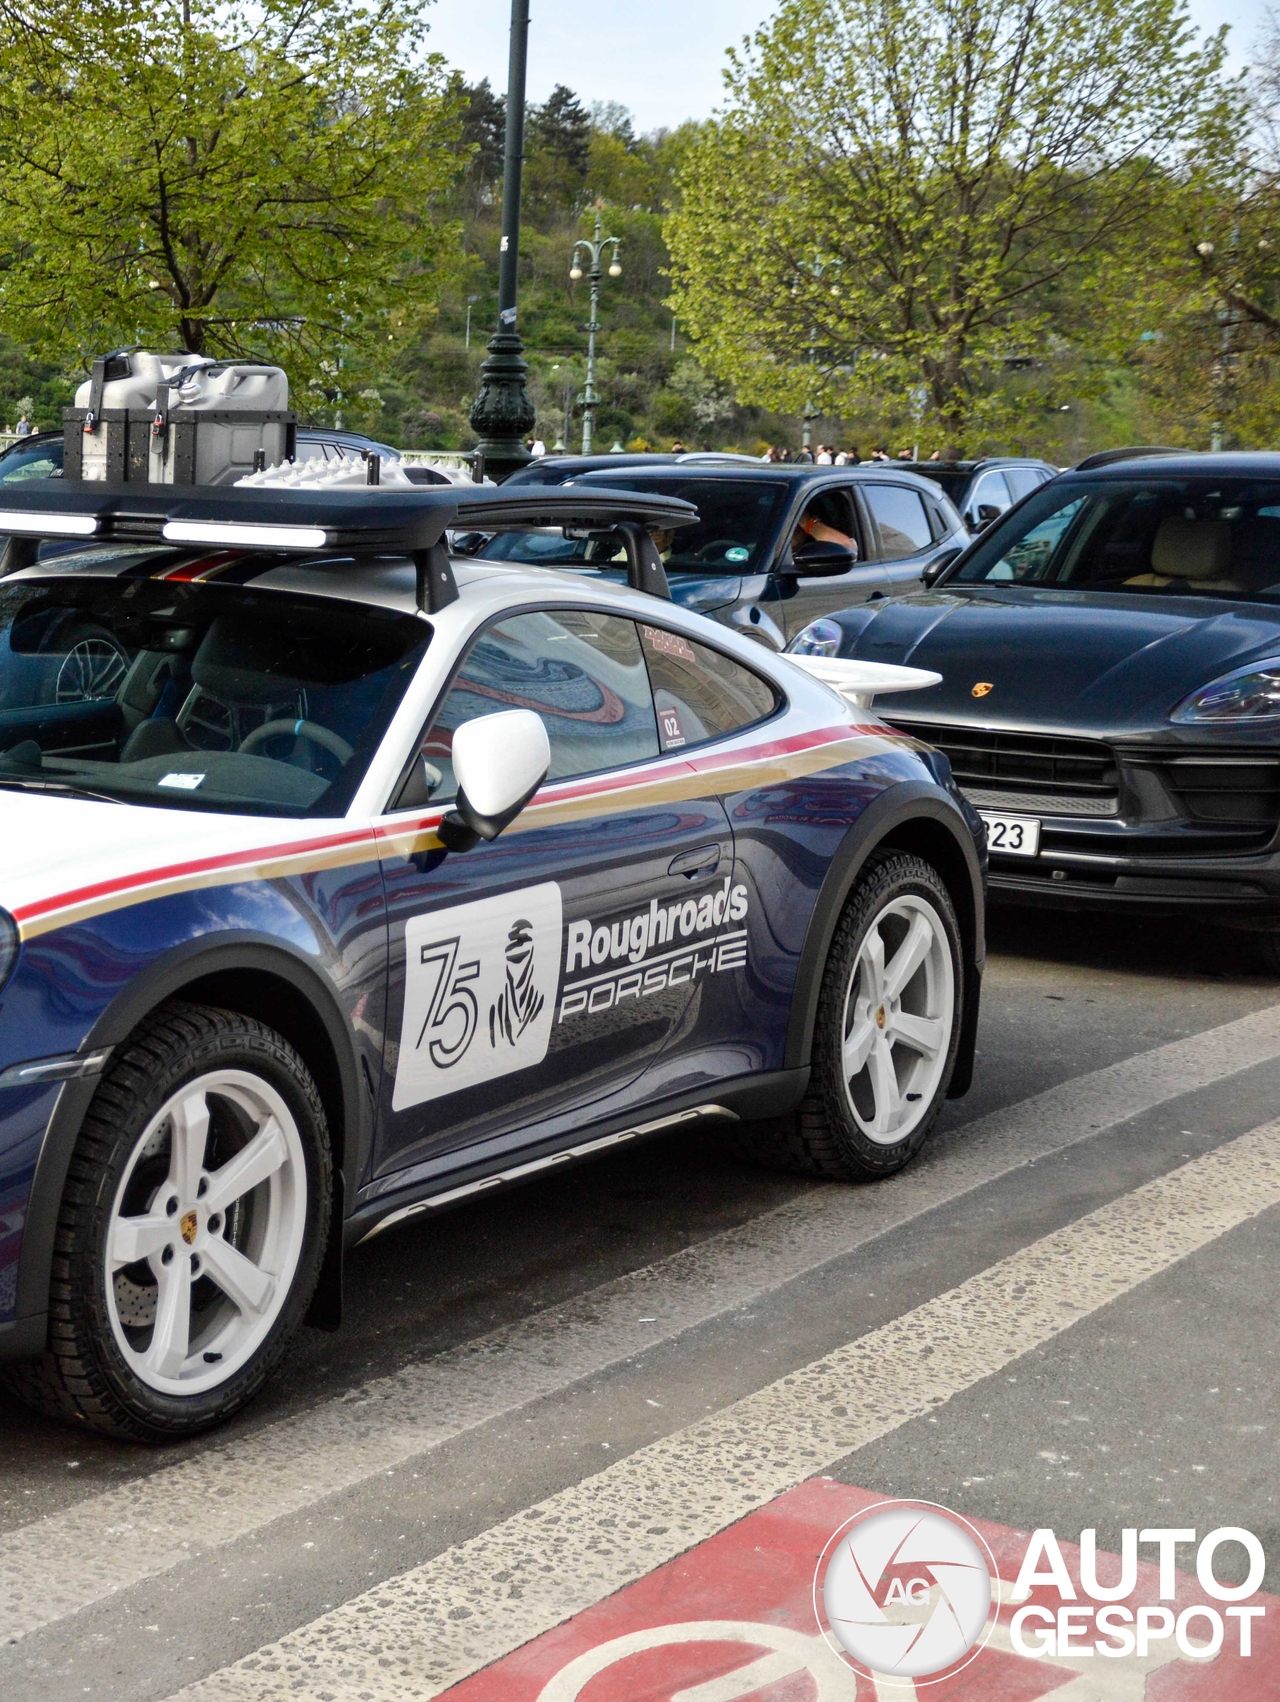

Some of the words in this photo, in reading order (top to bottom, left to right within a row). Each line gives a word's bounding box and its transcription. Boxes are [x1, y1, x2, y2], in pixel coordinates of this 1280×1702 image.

[664, 717, 680, 736] 02
[565, 877, 748, 973] Roughroads
[416, 935, 481, 1070] 75
[558, 940, 748, 1024] PORSCHE
